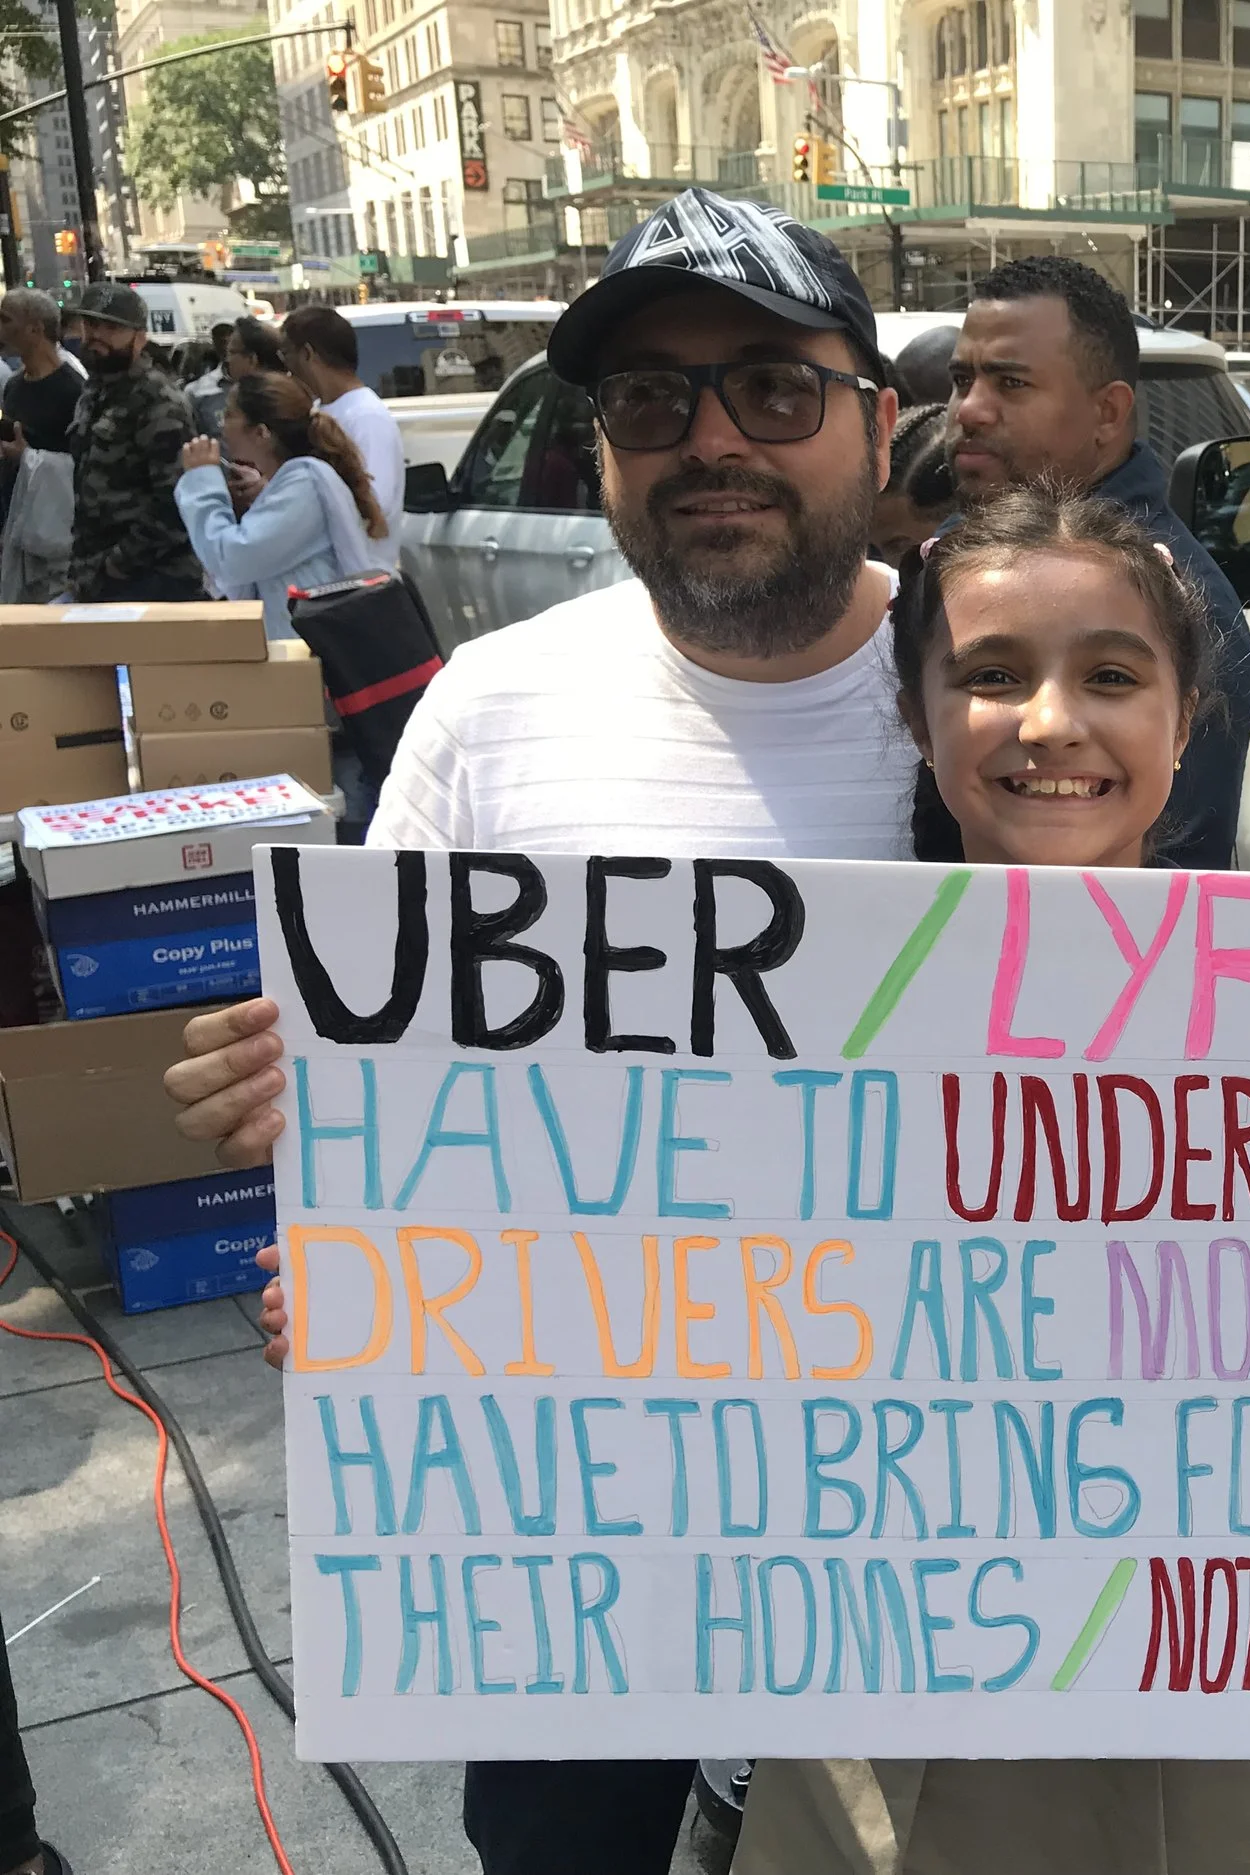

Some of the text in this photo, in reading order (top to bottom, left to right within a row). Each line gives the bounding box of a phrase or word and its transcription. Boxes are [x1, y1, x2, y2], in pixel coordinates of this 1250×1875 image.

[459, 84, 484, 158] PARK
[844, 187, 883, 202] Park Pl
[133, 889, 255, 917] HAMMERMILL
[153, 937, 253, 964] Copy Plus
[270, 846, 806, 1060] UBER
[293, 1057, 732, 1220] HAVE
[772, 1069, 900, 1221] TO
[215, 1234, 268, 1255] Copy
[287, 1223, 873, 1381] DRIVERS
[890, 1237, 1063, 1383] ARE
[316, 1551, 630, 1697] THEIR
[695, 1553, 1041, 1697] HOMES
